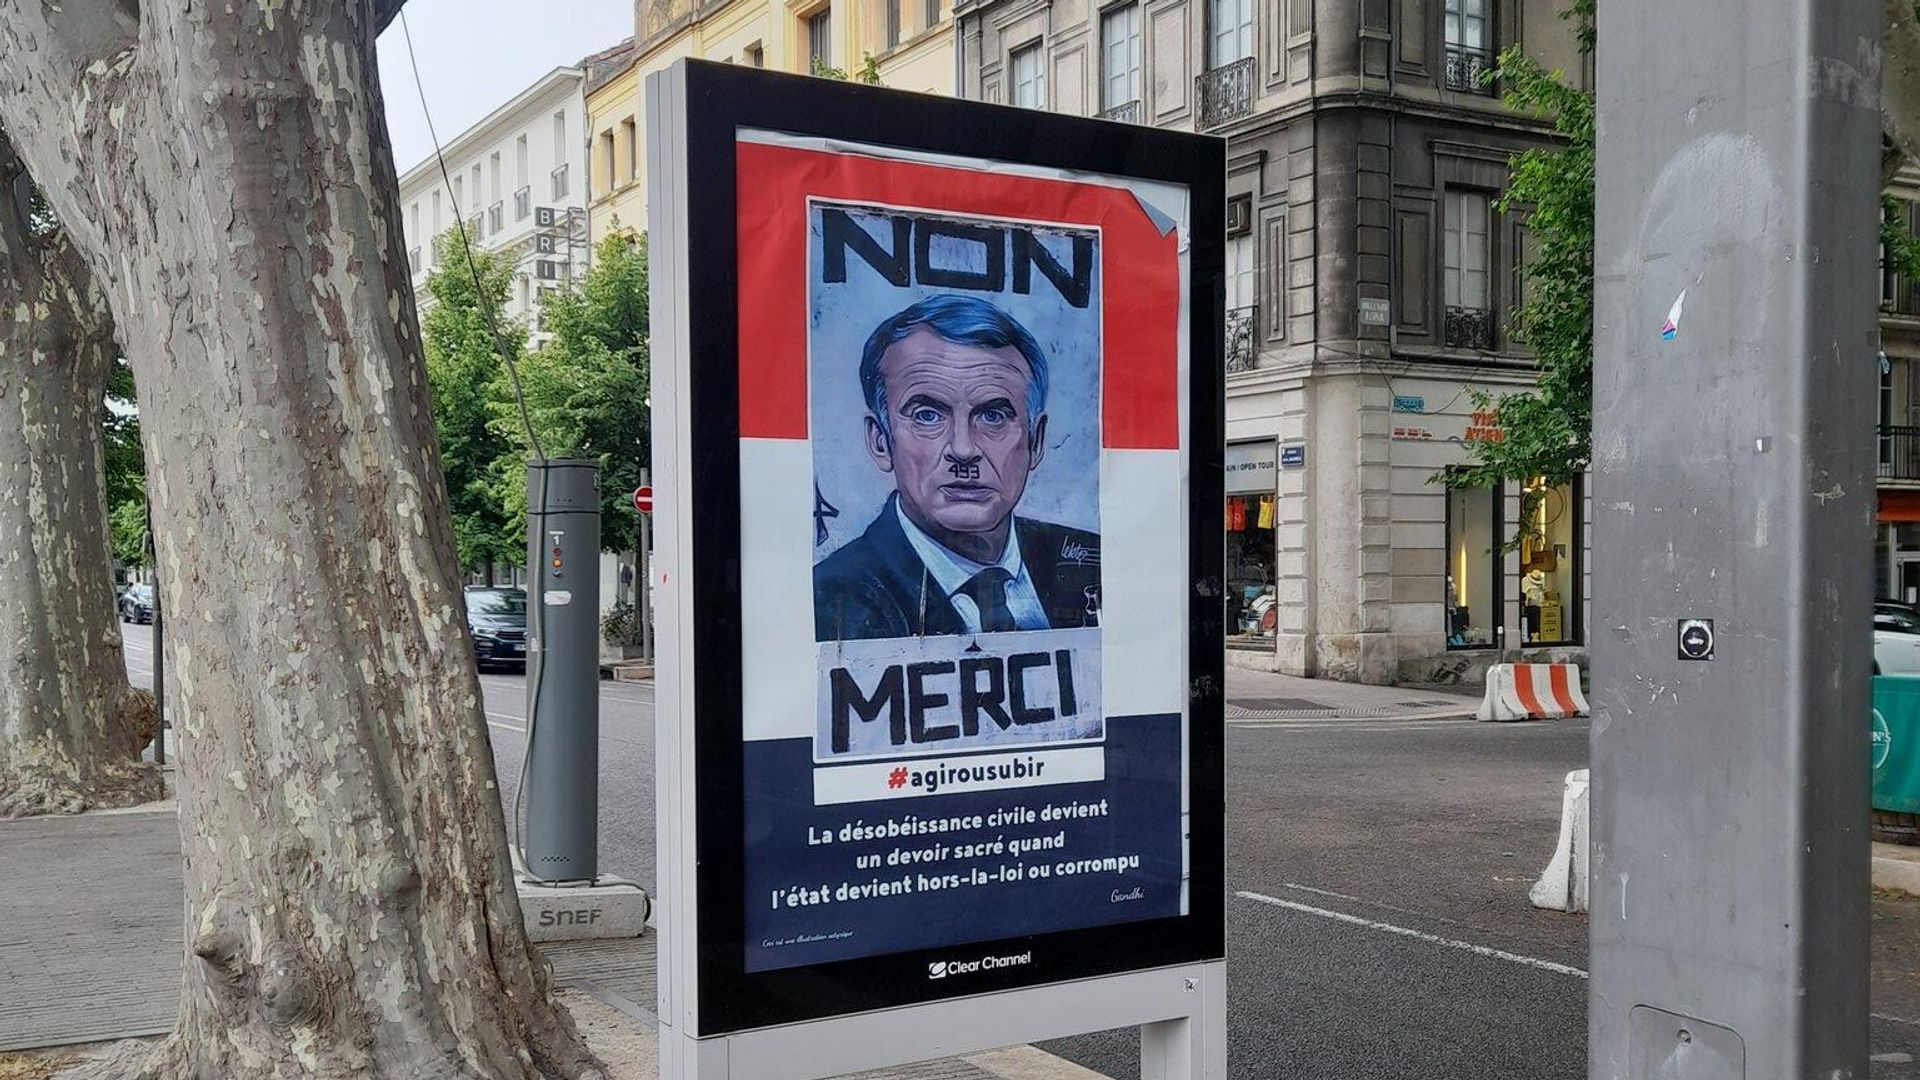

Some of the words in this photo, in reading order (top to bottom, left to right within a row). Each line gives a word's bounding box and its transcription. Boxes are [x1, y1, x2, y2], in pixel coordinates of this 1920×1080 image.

[822, 208, 1093, 308] NON
[1240, 462, 1257, 472] OPEN
[1258, 461, 1275, 470] TOUR
[830, 649, 1077, 754] MERCI
[888, 758, 1044, 792] #agirousubir
[808, 826, 833, 845] La
[838, 815, 983, 842] désobéissance
[987, 806, 1036, 827] civile
[1040, 799, 1108, 822] devient
[856, 854, 881, 869] un
[887, 843, 950, 866] devoir
[954, 835, 1003, 859] sacré
[1008, 831, 1065, 857] quand
[772, 885, 830, 909] l'état
[836, 875, 912, 901] devient
[918, 862, 1023, 892] hors-la-loi
[1028, 864, 1050, 879] ou
[1055, 855, 1139, 874] corrompu
[1110, 887, 1144, 903] Gandhi
[947, 961, 980, 975] Clear
[982, 950, 1031, 970] Channel
